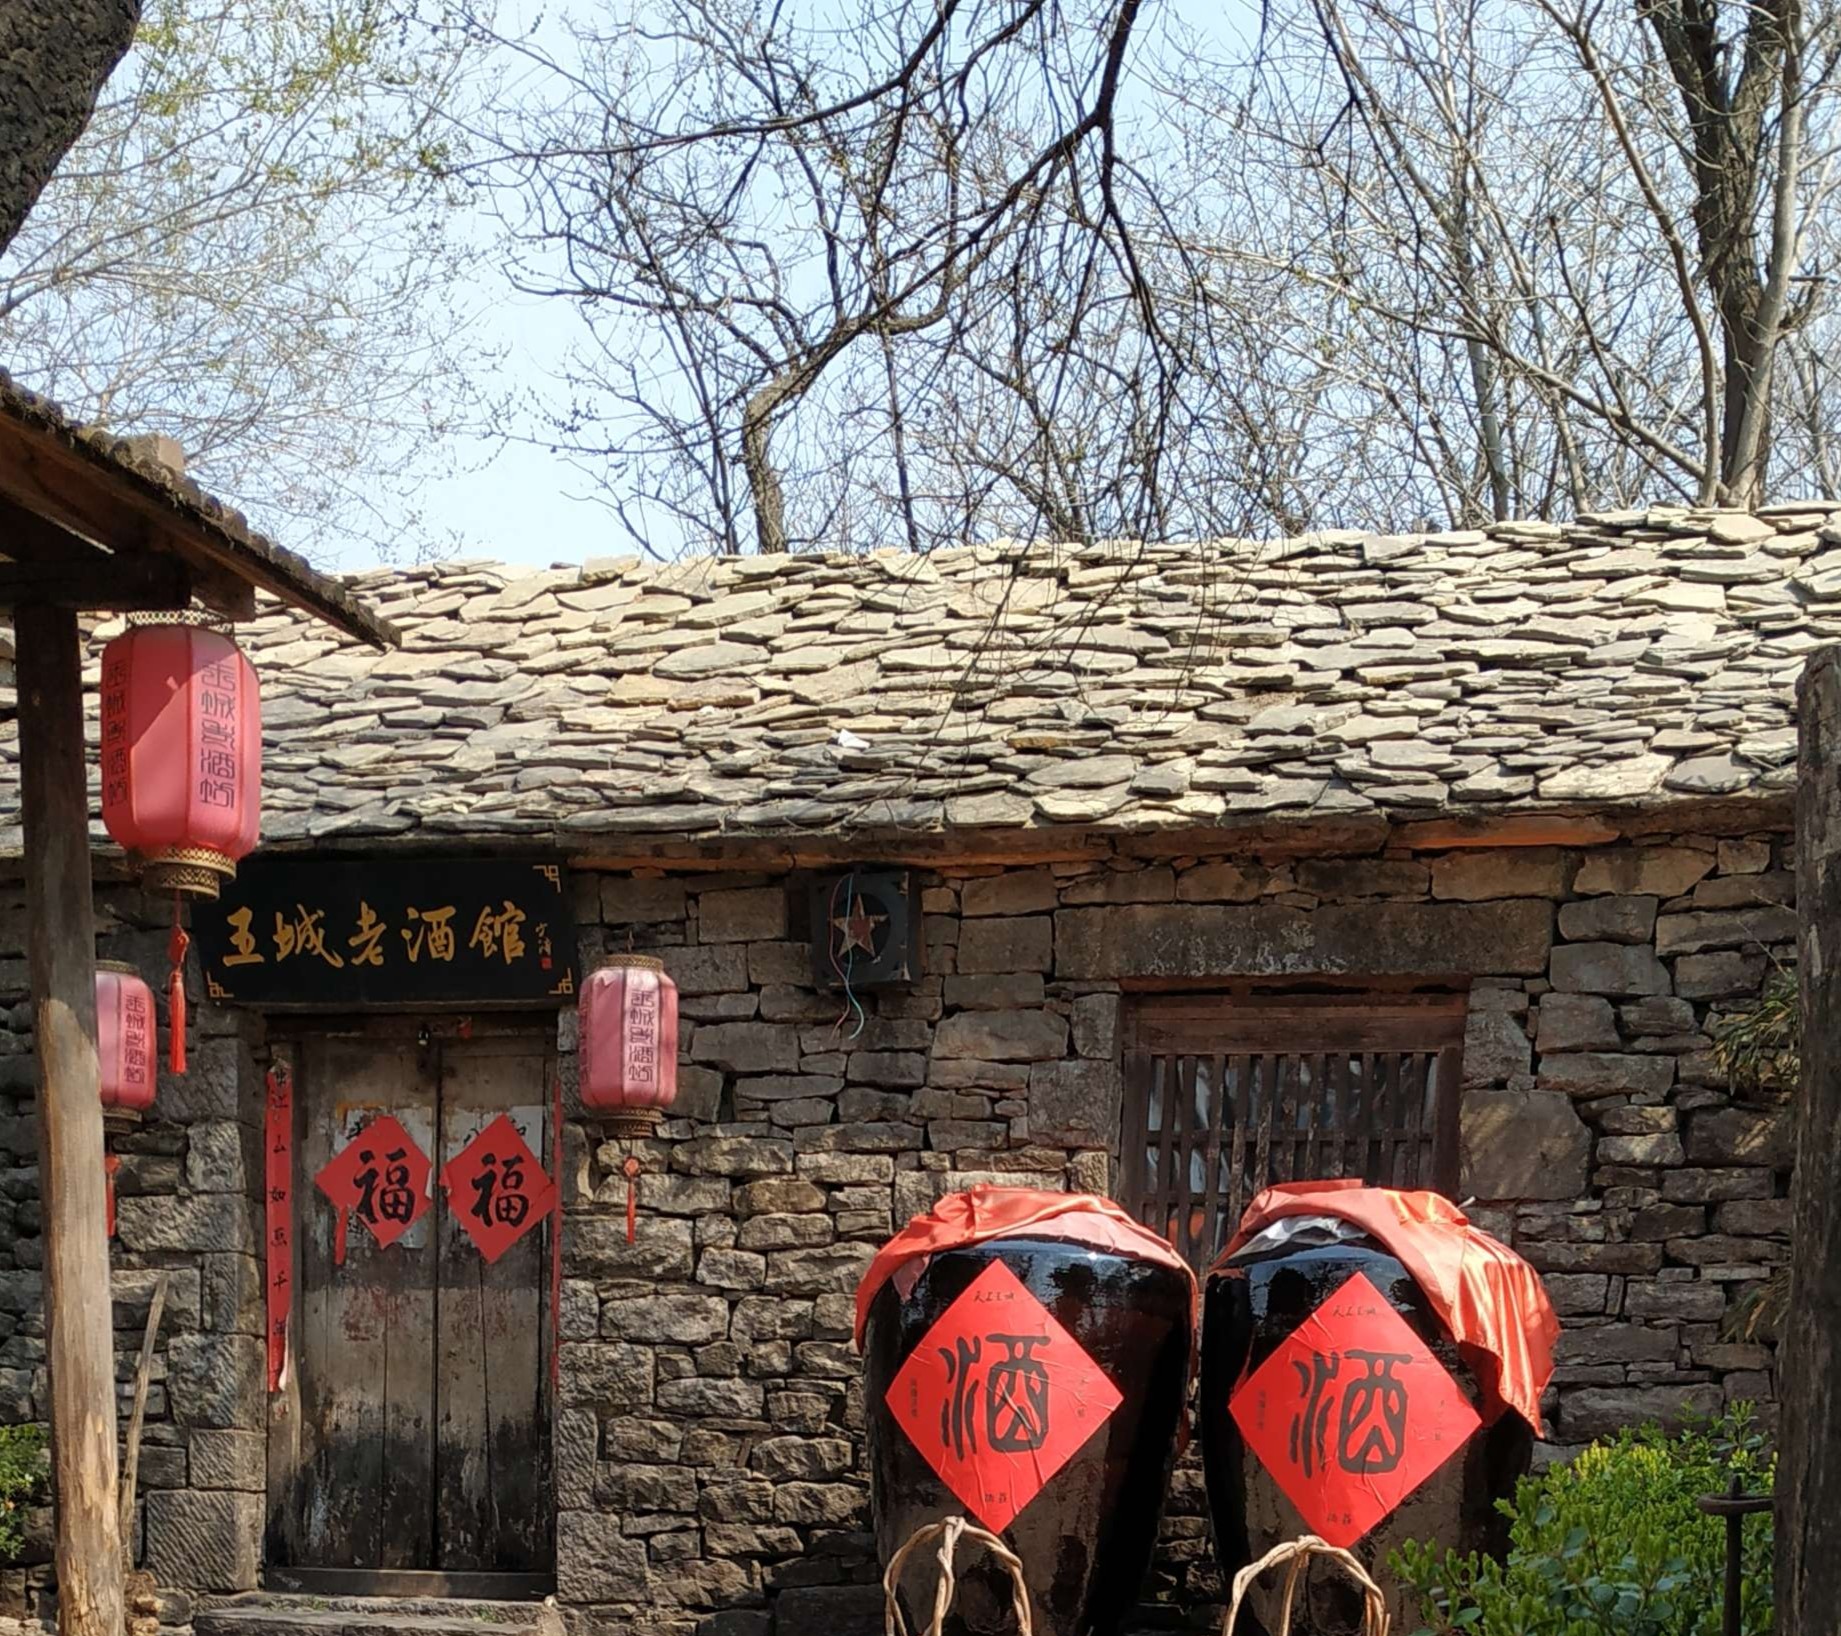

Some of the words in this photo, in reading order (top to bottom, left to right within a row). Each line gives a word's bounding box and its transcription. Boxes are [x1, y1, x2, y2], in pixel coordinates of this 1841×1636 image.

[353, 1147, 415, 1224] 福
[471, 1152, 529, 1227] 福
[938, 1333, 1051, 1461] 酒
[1291, 1349, 1413, 1478] 酒
